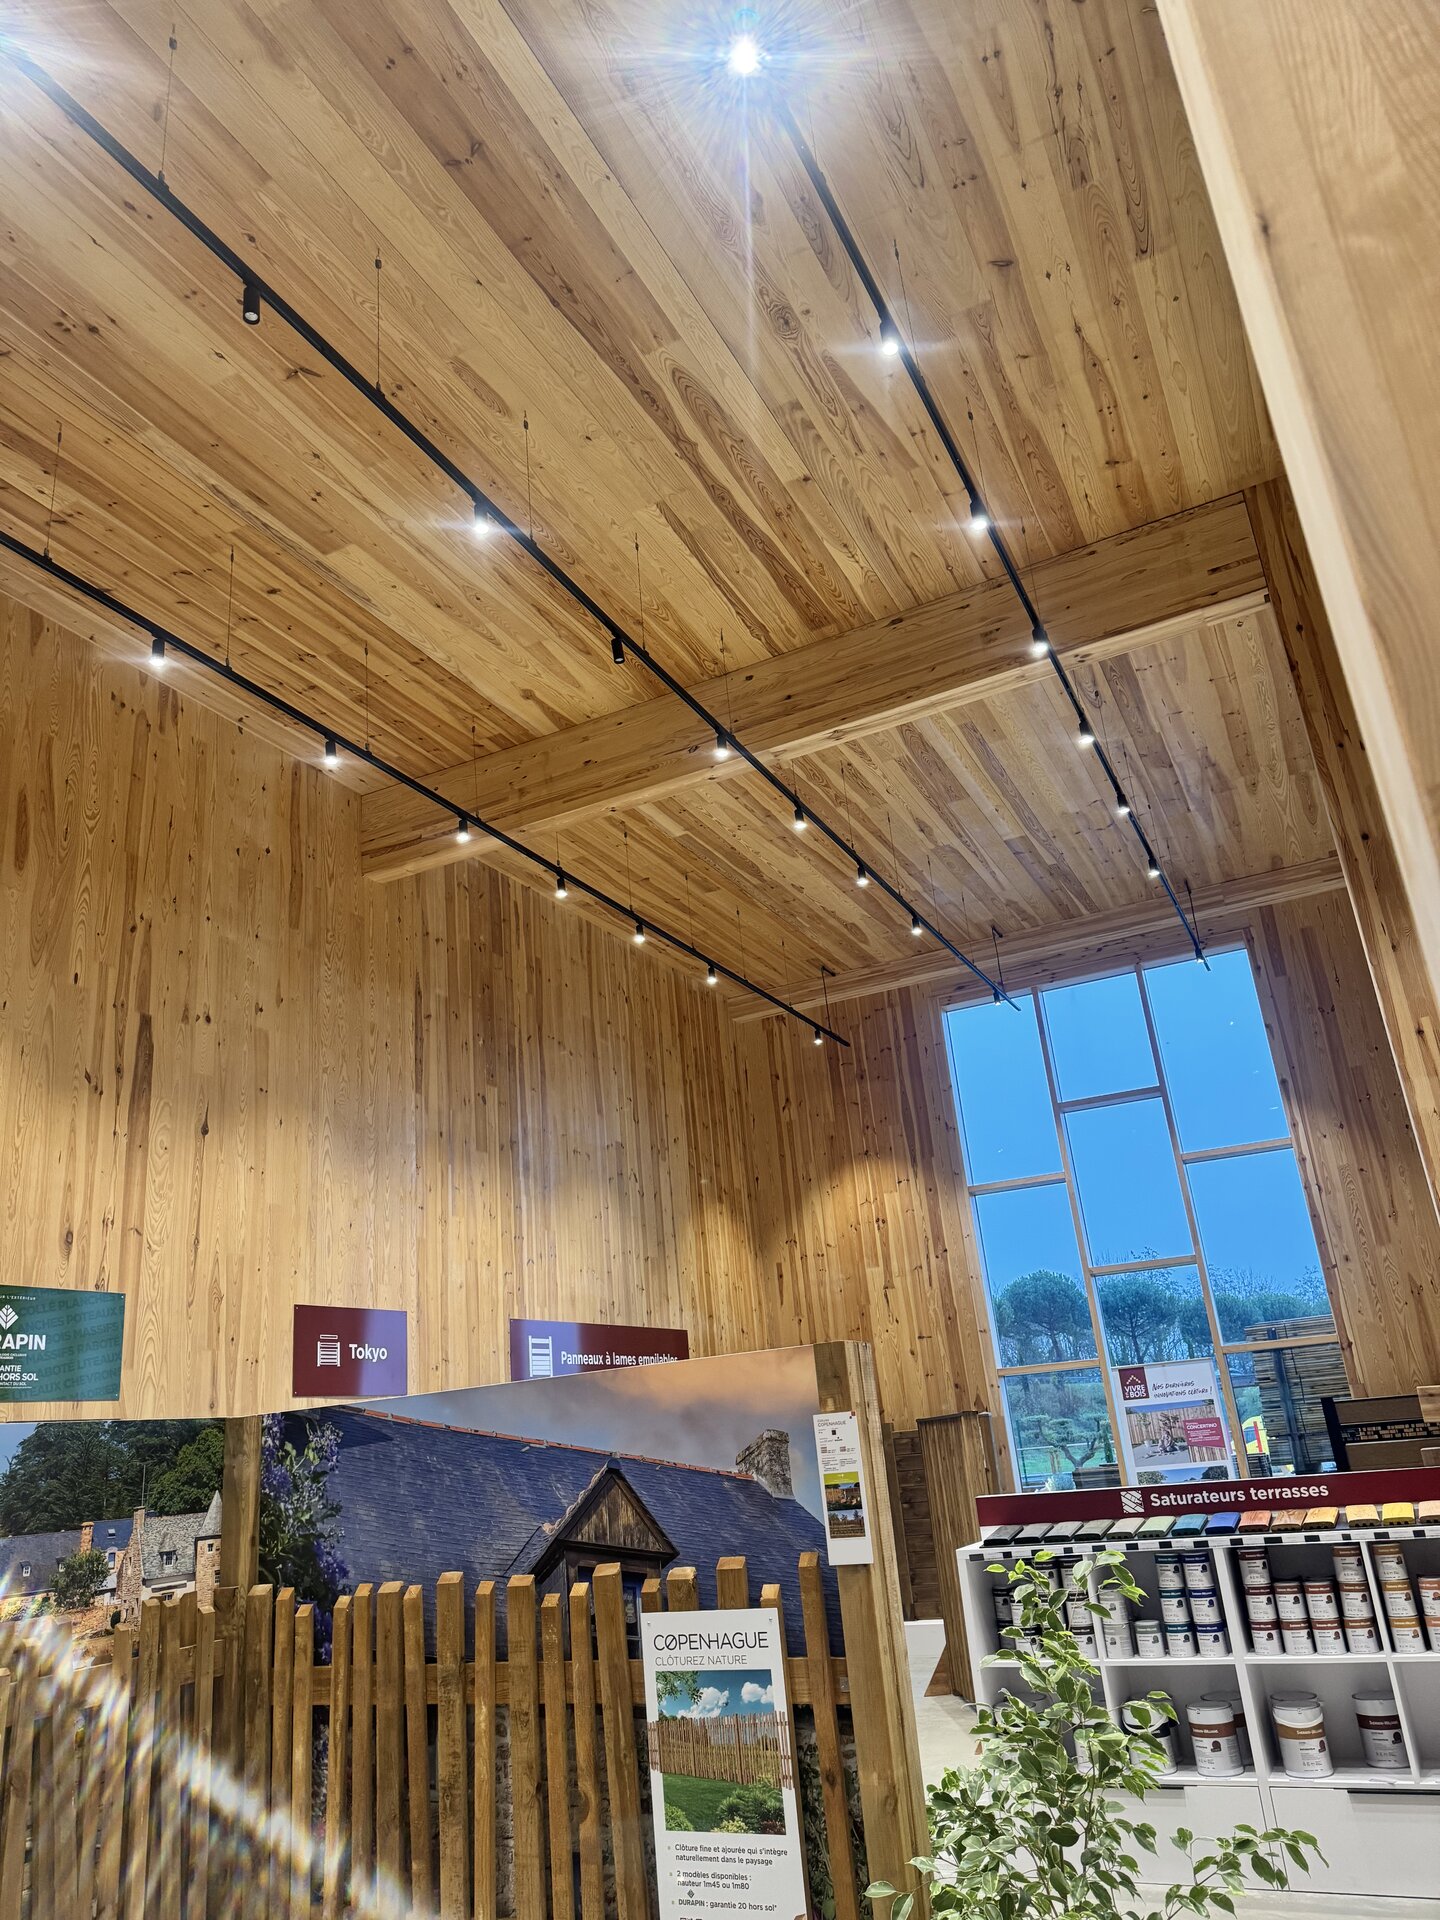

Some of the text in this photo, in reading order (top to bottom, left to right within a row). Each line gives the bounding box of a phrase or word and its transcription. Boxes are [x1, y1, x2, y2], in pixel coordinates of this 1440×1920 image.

[349, 1343, 388, 1362] Tokyo
[561, 1351, 604, 1366] Panneaux
[606, 1352, 611, 1365] à
[613, 1352, 636, 1366] lames
[22, 1373, 39, 1381] SOL
[1124, 1384, 1146, 1392] VIVRE
[1130, 1390, 1147, 1398] BOIS
[1150, 1484, 1329, 1508] Saturateurs terrasses
[655, 1655, 747, 1666] CLÔTUREZ NATURE
[675, 1844, 698, 1852] Clôture
[700, 1845, 712, 1853] fine
[722, 1847, 746, 1856] ajourée
[747, 1848, 758, 1857] qui
[676, 1854, 773, 1866] naturellement dans le paysage
[683, 1871, 710, 1880] modèles
[711, 1872, 748, 1881] disponibles
[732, 1882, 750, 1890] 1m80
[678, 1899, 705, 1907] DURAPIN
[710, 1901, 737, 1910] garantie
[738, 1902, 747, 1910] 20
[749, 1903, 764, 1911] hors
